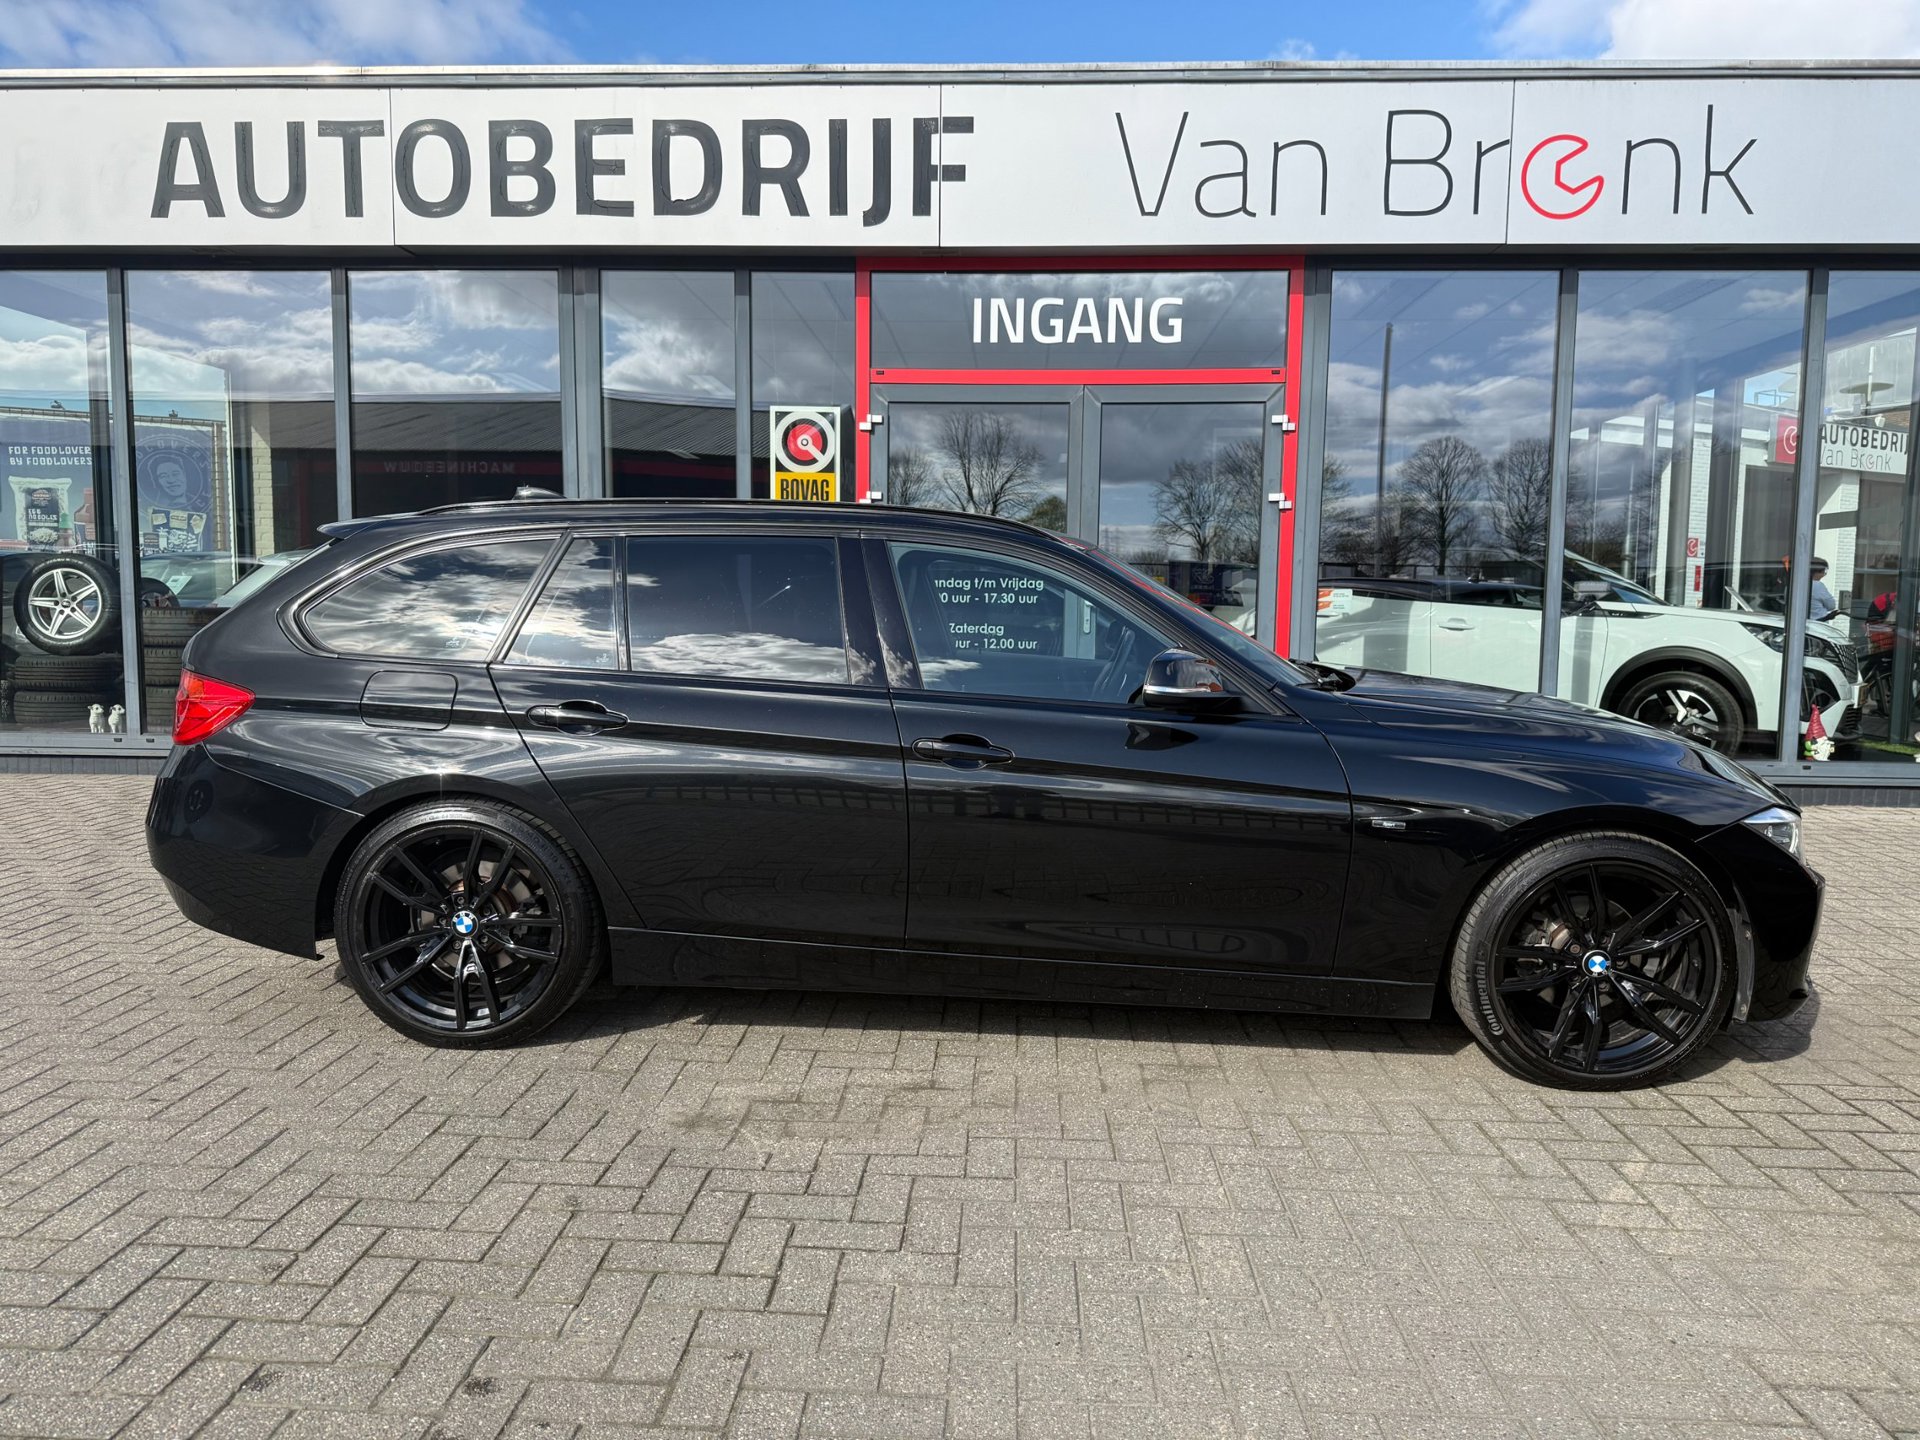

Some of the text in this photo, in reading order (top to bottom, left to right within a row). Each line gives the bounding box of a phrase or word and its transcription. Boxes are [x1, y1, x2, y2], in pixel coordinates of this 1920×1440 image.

[151, 116, 975, 228] AUTOBEDRIJF
[1115, 111, 1327, 218] Van
[973, 297, 1184, 344] INGANG
[1820, 424, 1909, 455] AUTOBEDRIJ
[8, 446, 92, 455] FOR FOODLOVER
[10, 457, 92, 465] BY FOODLOVERS
[780, 479, 829, 501] BOVAG
[974, 578, 996, 589] t/m
[1000, 578, 1044, 591] Vrijdag
[952, 595, 971, 603] uur
[984, 593, 1015, 603] 17.30
[1018, 595, 1038, 603] uur
[949, 623, 1004, 636] Zaterdag
[983, 638, 1014, 649] 12.00
[1018, 640, 1037, 649] uur
[1473, 960, 1504, 1036] Continental
